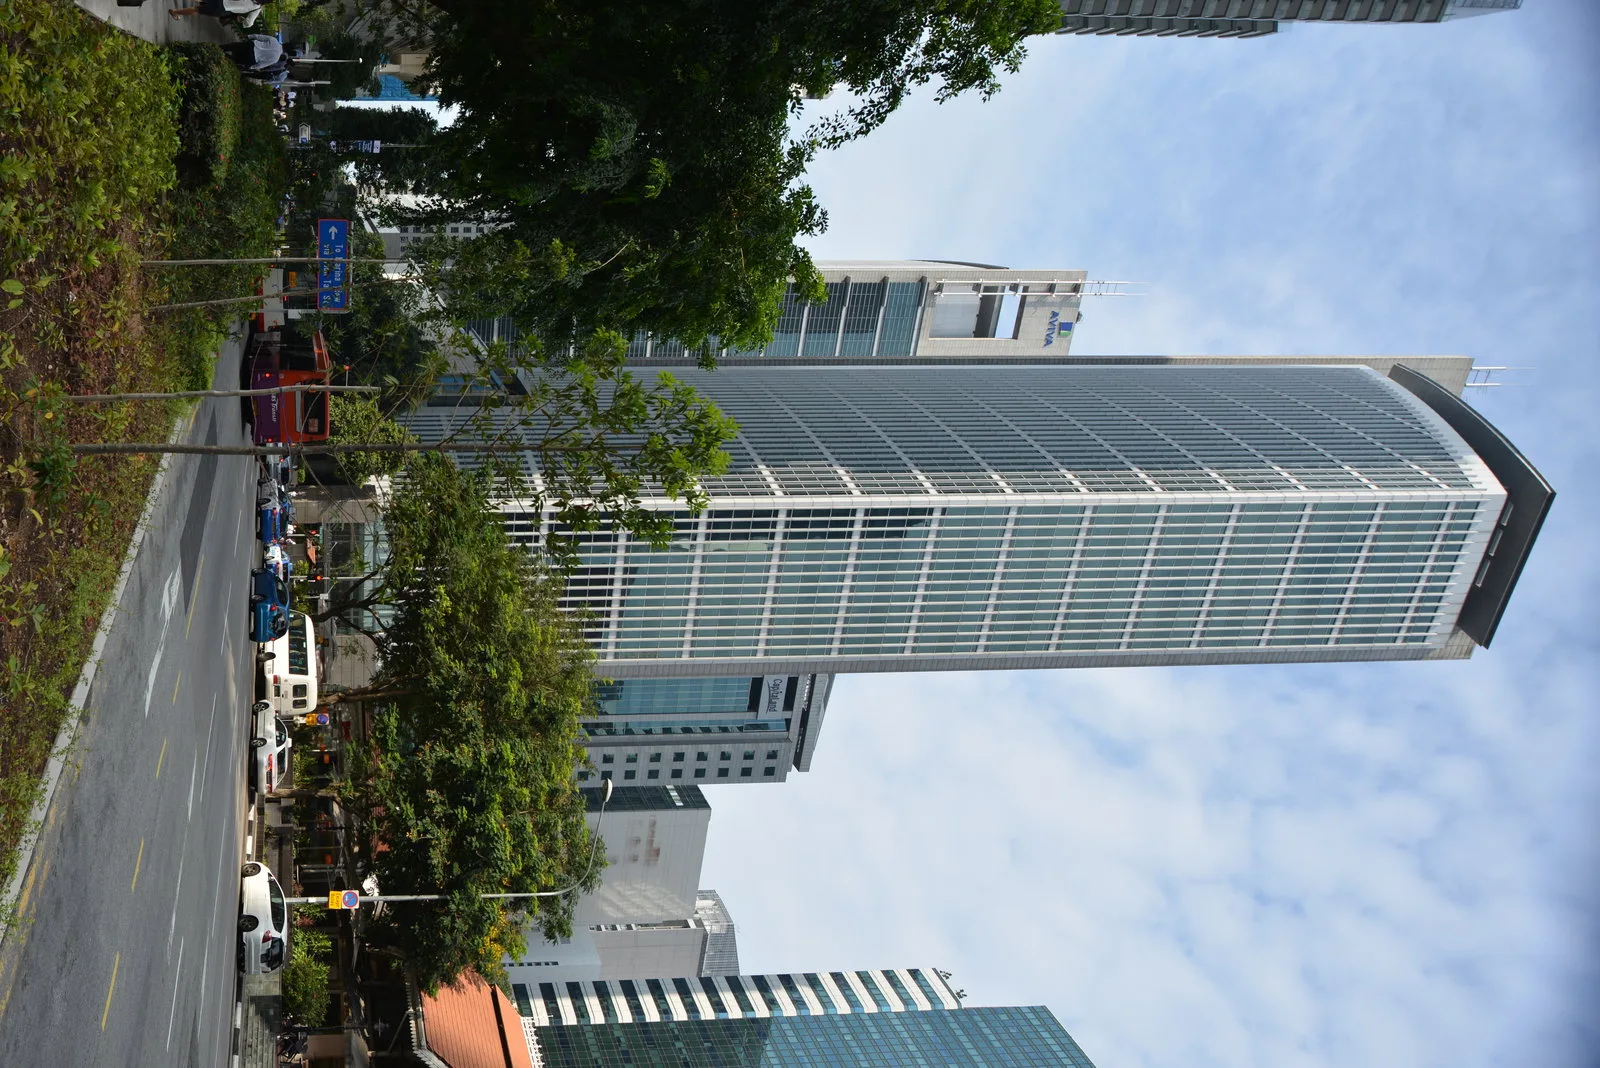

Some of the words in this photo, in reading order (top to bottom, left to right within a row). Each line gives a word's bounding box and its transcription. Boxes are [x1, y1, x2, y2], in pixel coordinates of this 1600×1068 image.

[335, 244, 343, 252] To
[1044, 311, 1060, 347] AVIVA
[769, 679, 782, 712] CapitaLand
